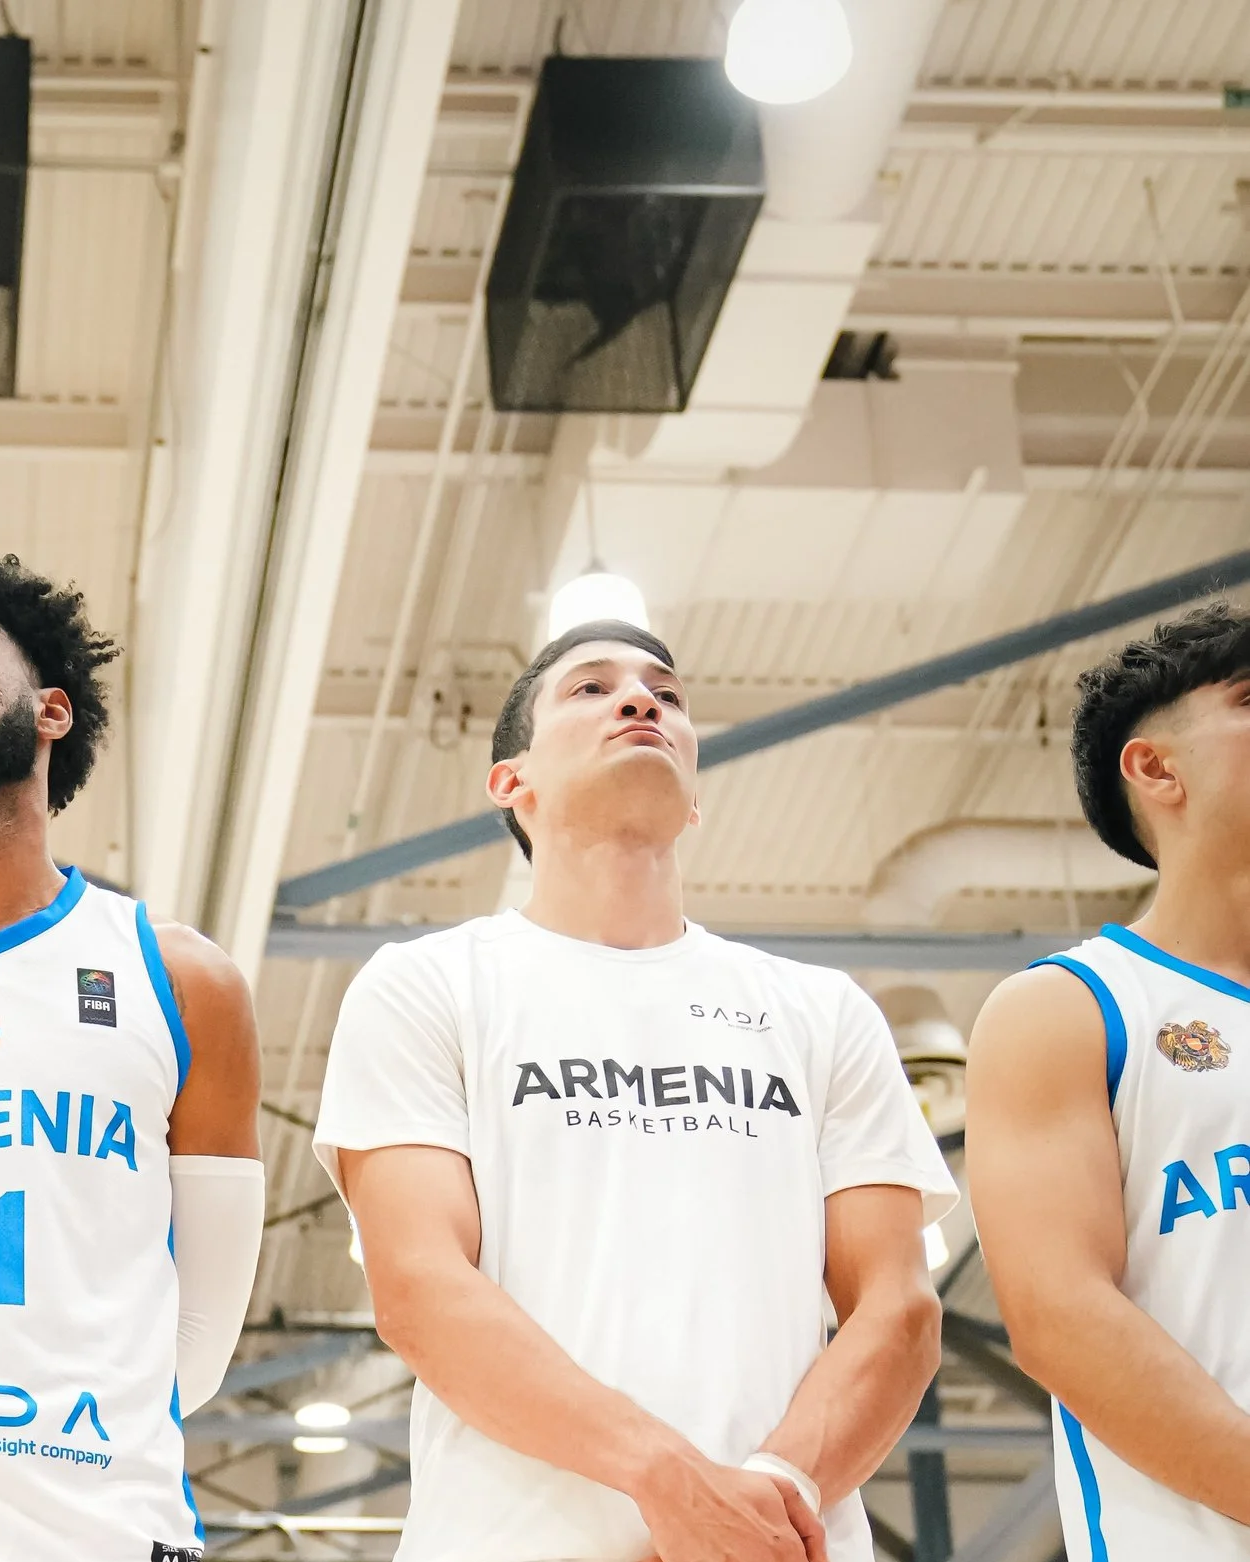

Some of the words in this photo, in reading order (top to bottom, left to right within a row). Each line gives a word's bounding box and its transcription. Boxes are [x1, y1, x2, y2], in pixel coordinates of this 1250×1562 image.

[84, 1000, 111, 1012] FIBA
[512, 1058, 802, 1118] ARMENIA
[565, 1109, 758, 1138] BASKETBALL
[40, 1444, 112, 1469] company
[162, 1545, 180, 1553] SIZE
